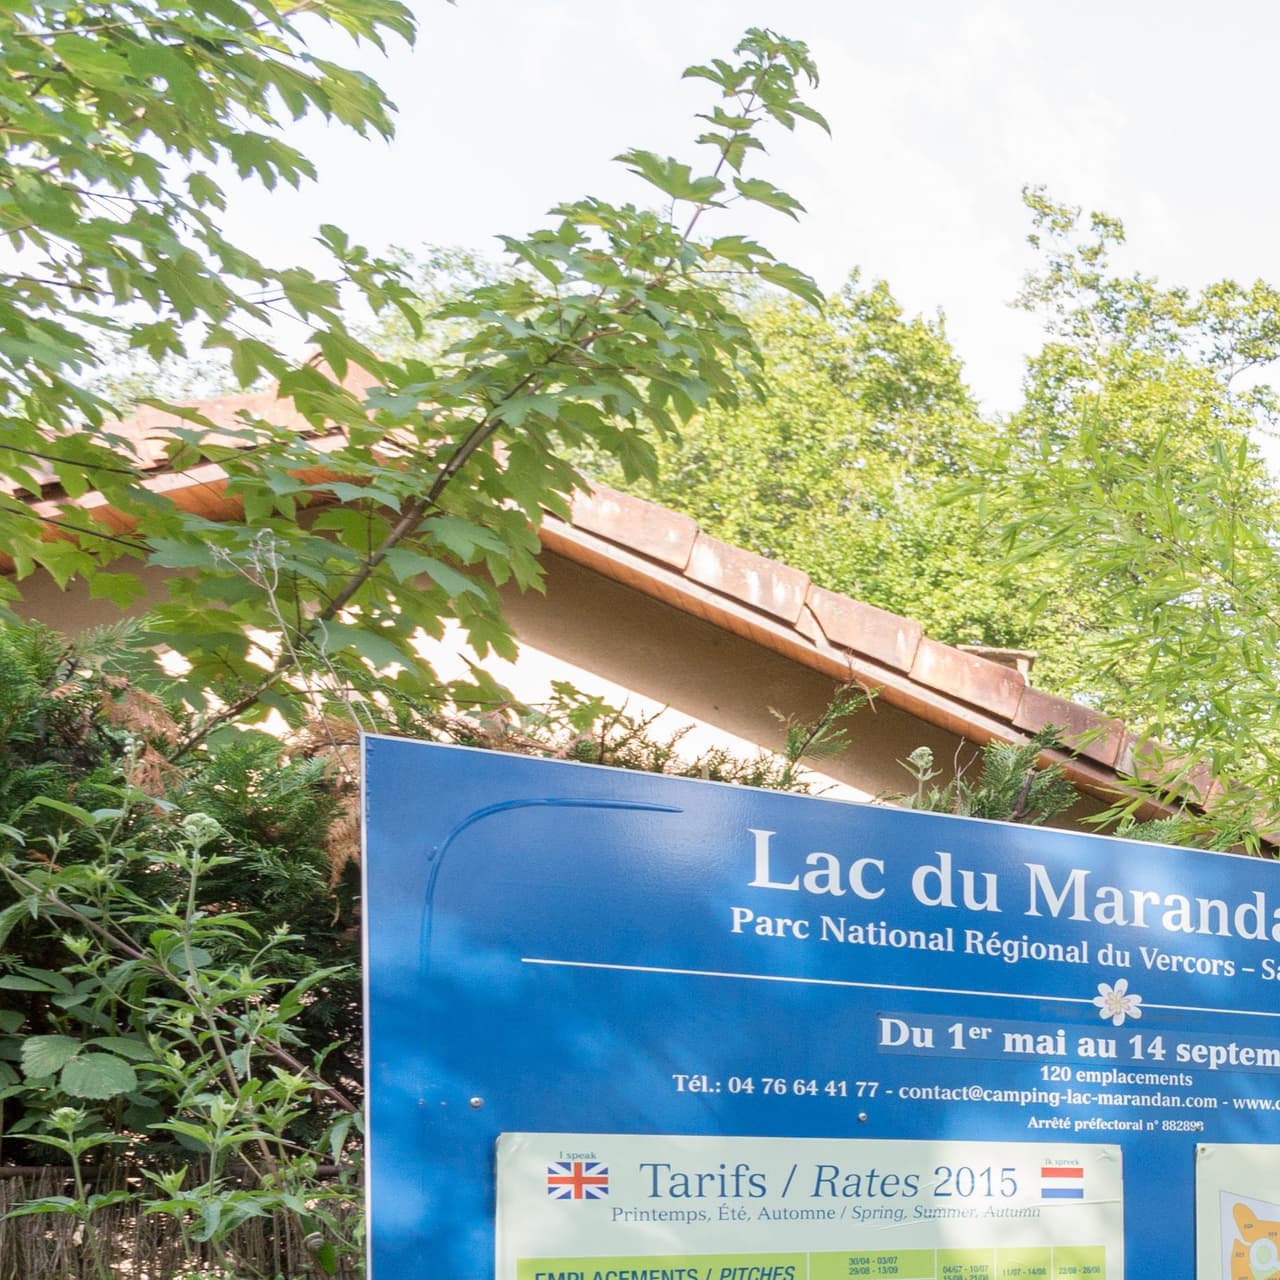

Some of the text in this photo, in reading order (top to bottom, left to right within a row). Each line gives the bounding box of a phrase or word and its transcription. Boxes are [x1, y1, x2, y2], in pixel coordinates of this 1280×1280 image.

[747, 827, 886, 900] Lac
[911, 851, 1003, 913] du
[730, 906, 811, 940] Parc
[820, 915, 955, 953] National
[963, 929, 1089, 964] Régional
[1096, 942, 1131, 968] du
[1139, 946, 1236, 978] Vercors
[879, 1017, 935, 1049] Du
[1002, 1028, 1068, 1056] mai
[1077, 1036, 1119, 1059] au
[1128, 1035, 1166, 1061] 14
[671, 1073, 722, 1094] Tél.:
[728, 1076, 755, 1095] 04
[761, 1078, 787, 1096] 76
[792, 1079, 819, 1097] 64
[824, 1080, 849, 1098] 41
[855, 1080, 880, 1098] 77
[899, 1084, 1218, 1110] contact@camping-lac-marandan.com
[1040, 1065, 1193, 1087] 120 emplacements
[1027, 1115, 1072, 1131] Arrêté
[1074, 1117, 1144, 1134] préfectoral
[640, 1163, 1018, 1199] Tarifs Rates 2015
[611, 1206, 712, 1225] Printemps,
[758, 1205, 837, 1221] Automne
[984, 1205, 1041, 1219] Autumn
